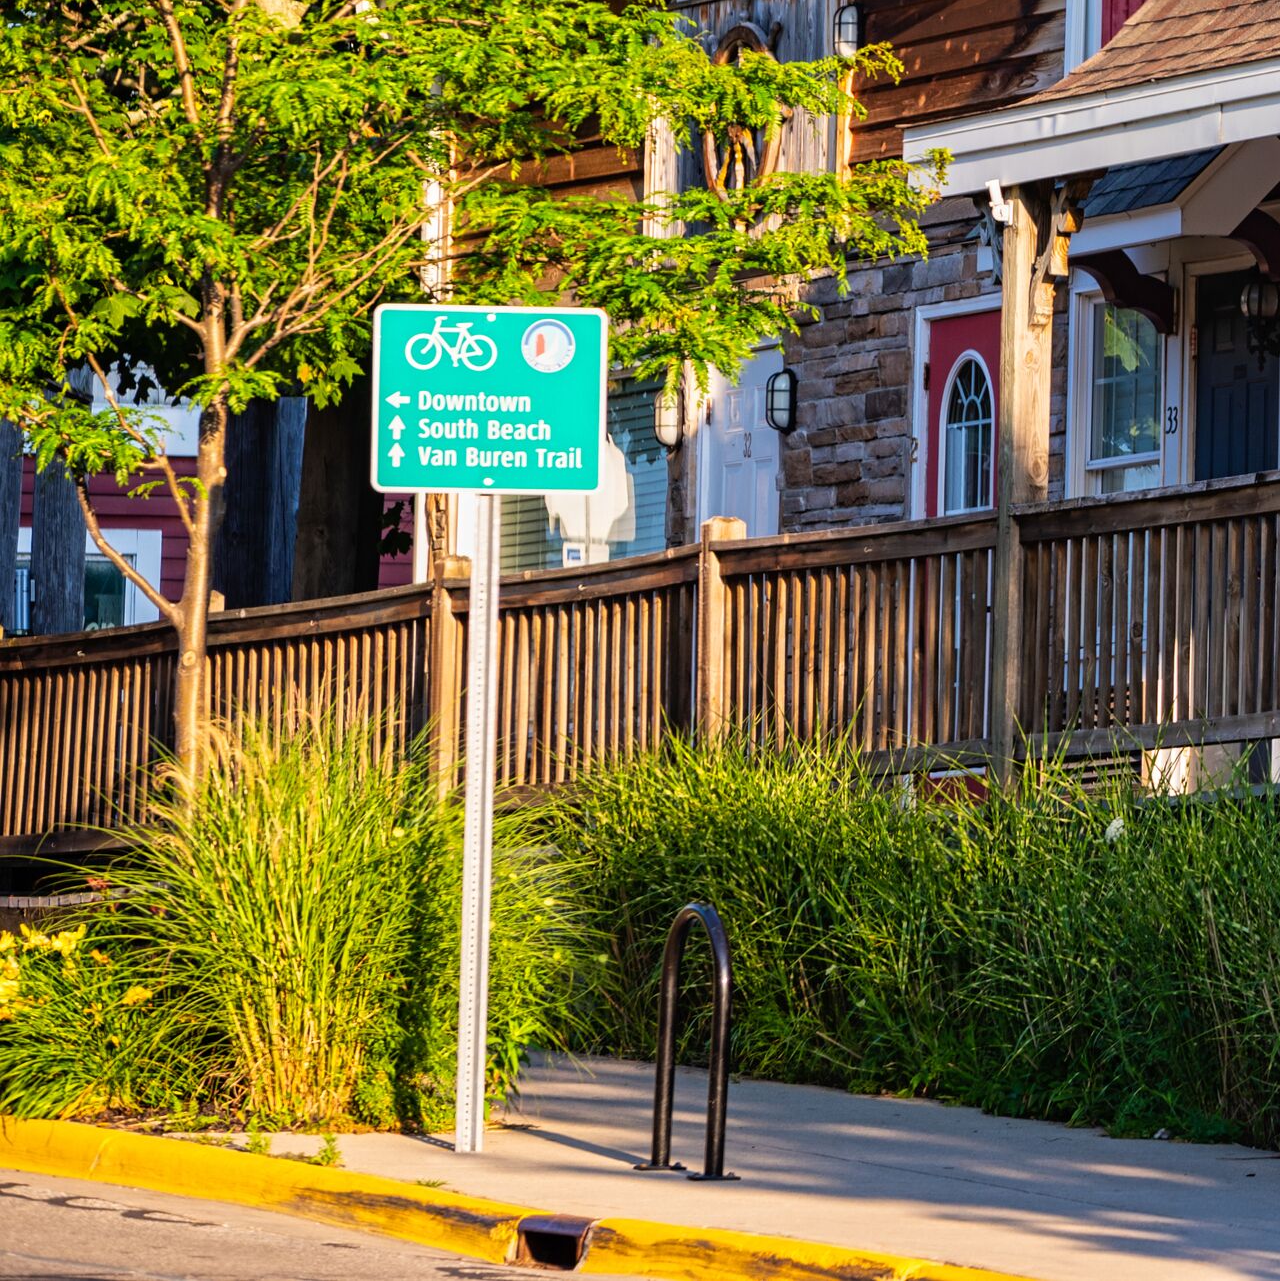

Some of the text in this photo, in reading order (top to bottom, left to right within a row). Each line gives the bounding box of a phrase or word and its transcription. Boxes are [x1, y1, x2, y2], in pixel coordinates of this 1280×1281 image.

[419, 391, 530, 412] Downtown
[419, 419, 550, 440] South Beach
[1165, 406, 1179, 434] 33
[418, 447, 582, 468] Van Buren Trail
